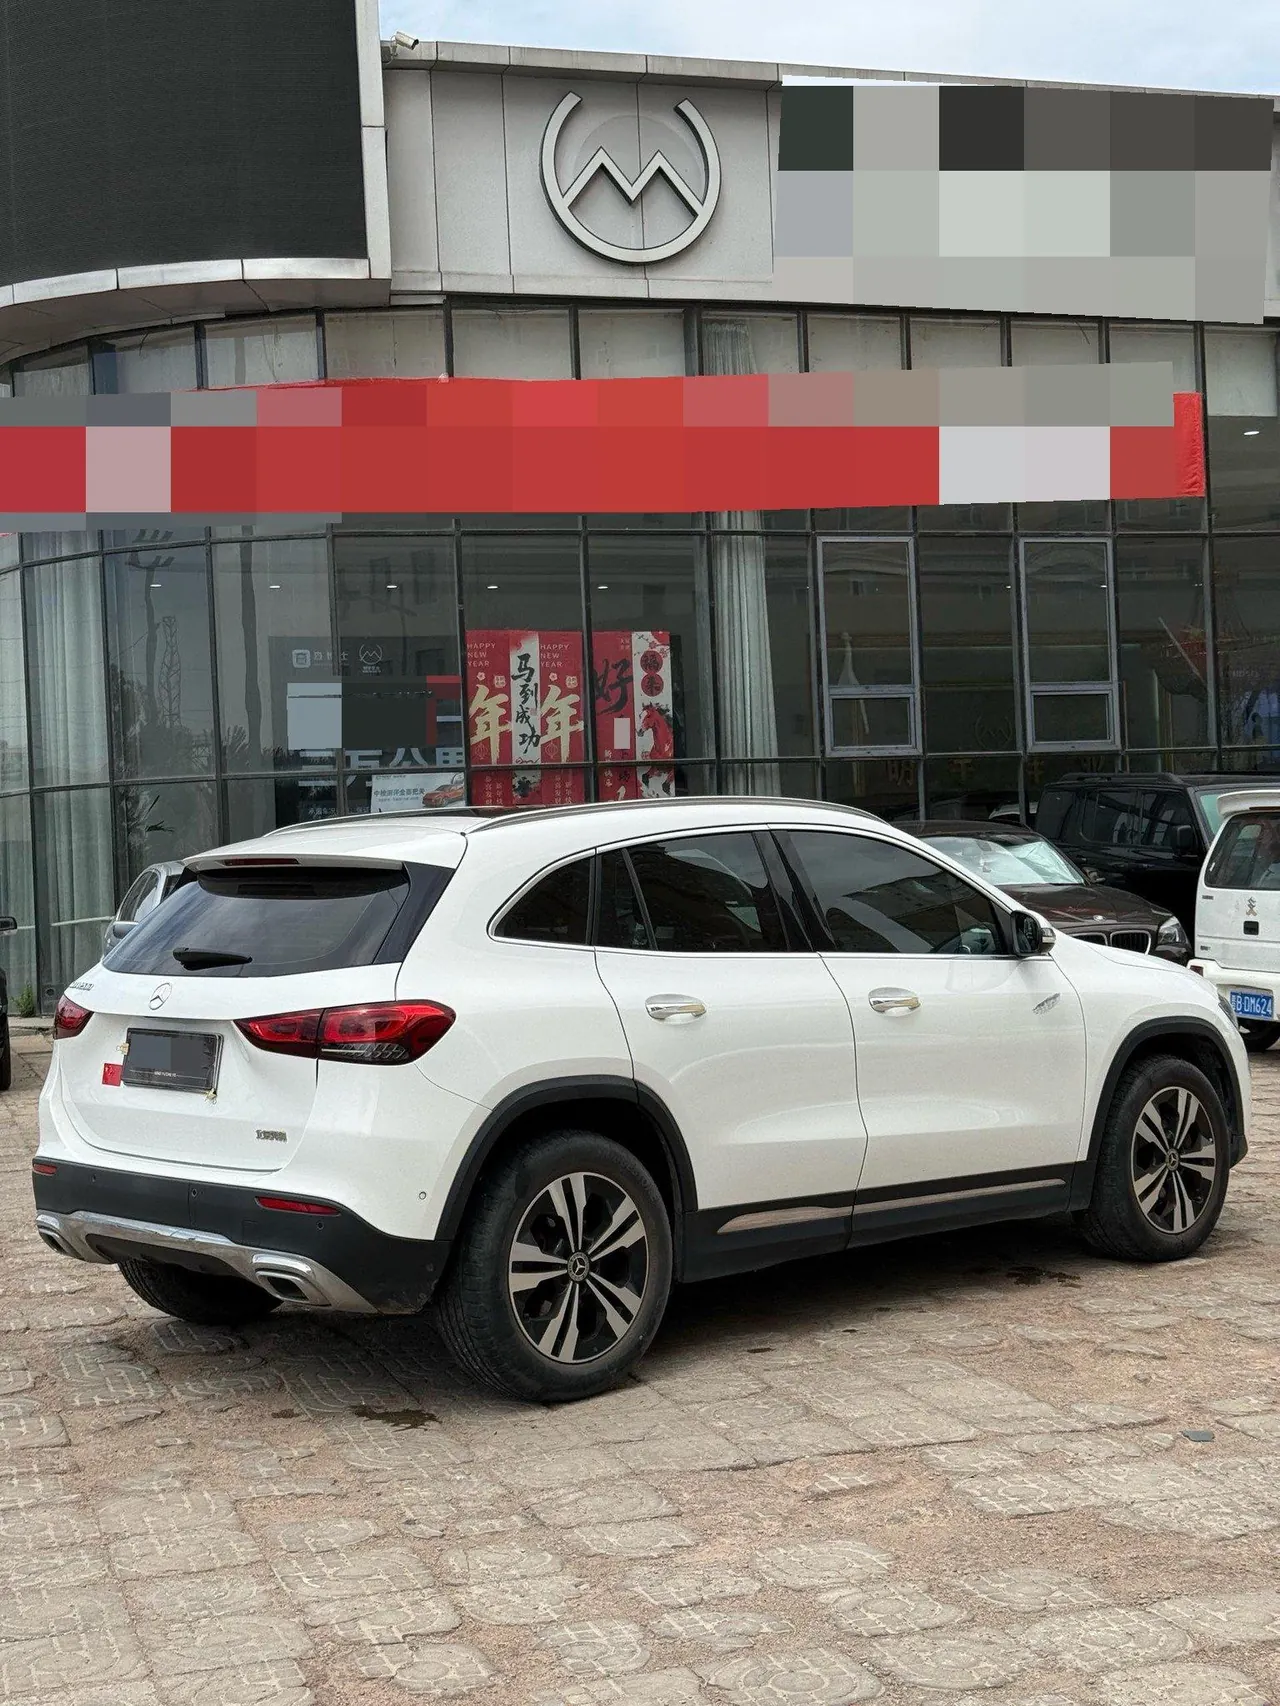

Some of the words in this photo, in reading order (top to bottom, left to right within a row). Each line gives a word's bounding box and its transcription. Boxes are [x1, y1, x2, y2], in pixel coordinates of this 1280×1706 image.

[467, 642, 496, 650] HAPPY
[540, 643, 570, 651] HAPPY
[467, 651, 487, 659] NEW
[467, 660, 490, 668] YEAR
[511, 653, 541, 753] 马到成功
[468, 684, 512, 765] 年
[540, 685, 584, 765] 年
